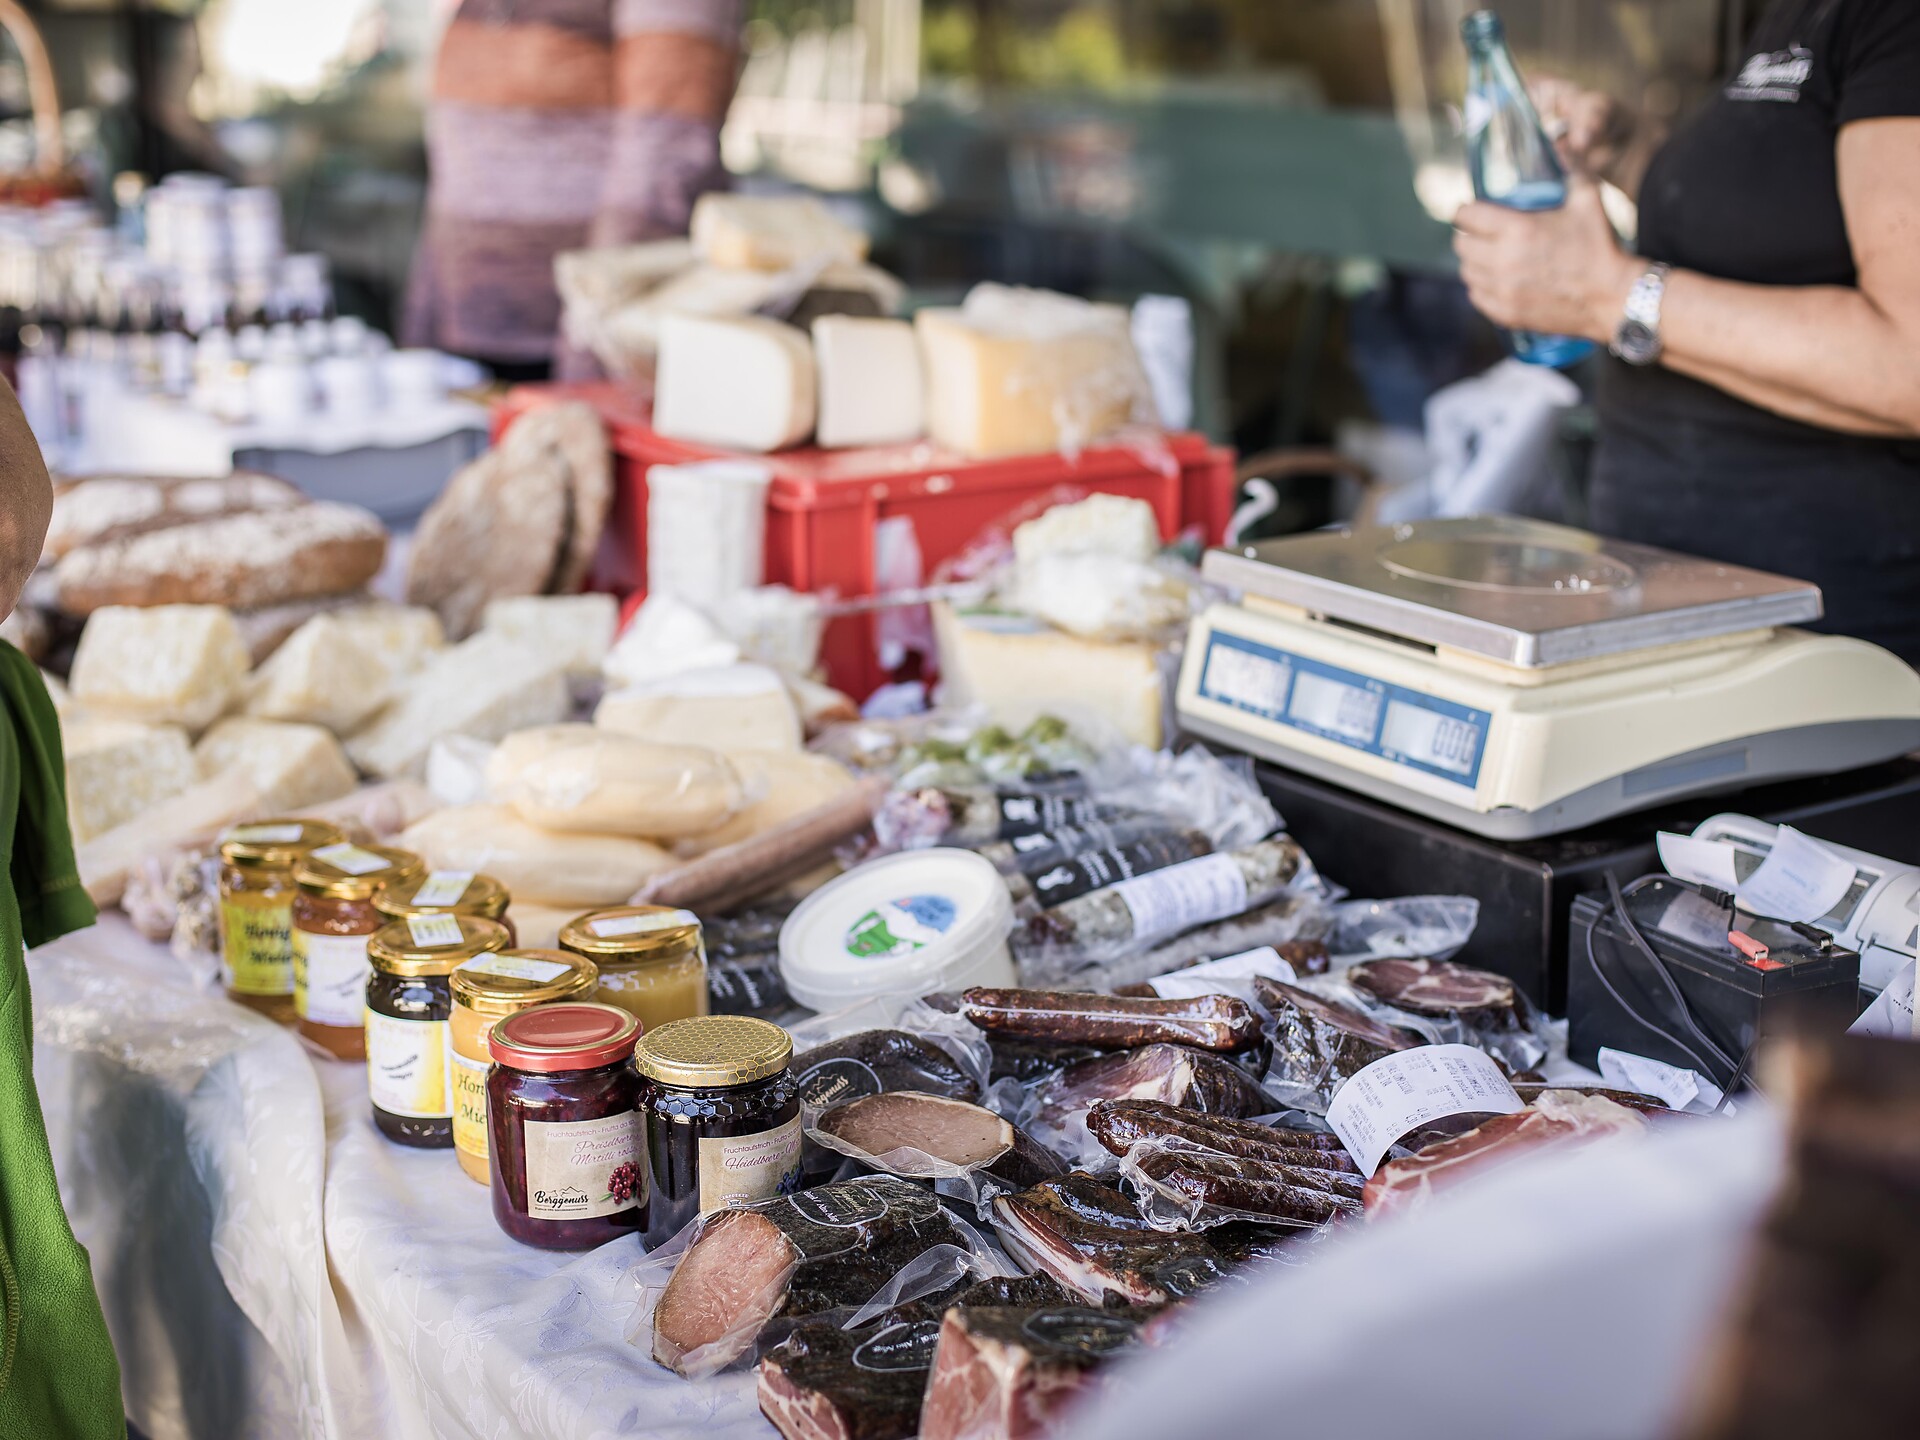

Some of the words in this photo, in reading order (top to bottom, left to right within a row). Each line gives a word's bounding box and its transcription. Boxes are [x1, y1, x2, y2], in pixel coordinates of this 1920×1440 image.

[547, 1128, 597, 1138] Fruchtaufstrich
[724, 1140, 771, 1154] Fruchtaufstrich
[725, 1152, 780, 1170] Heidelbeere
[535, 1191, 588, 1208] Berggenuss
